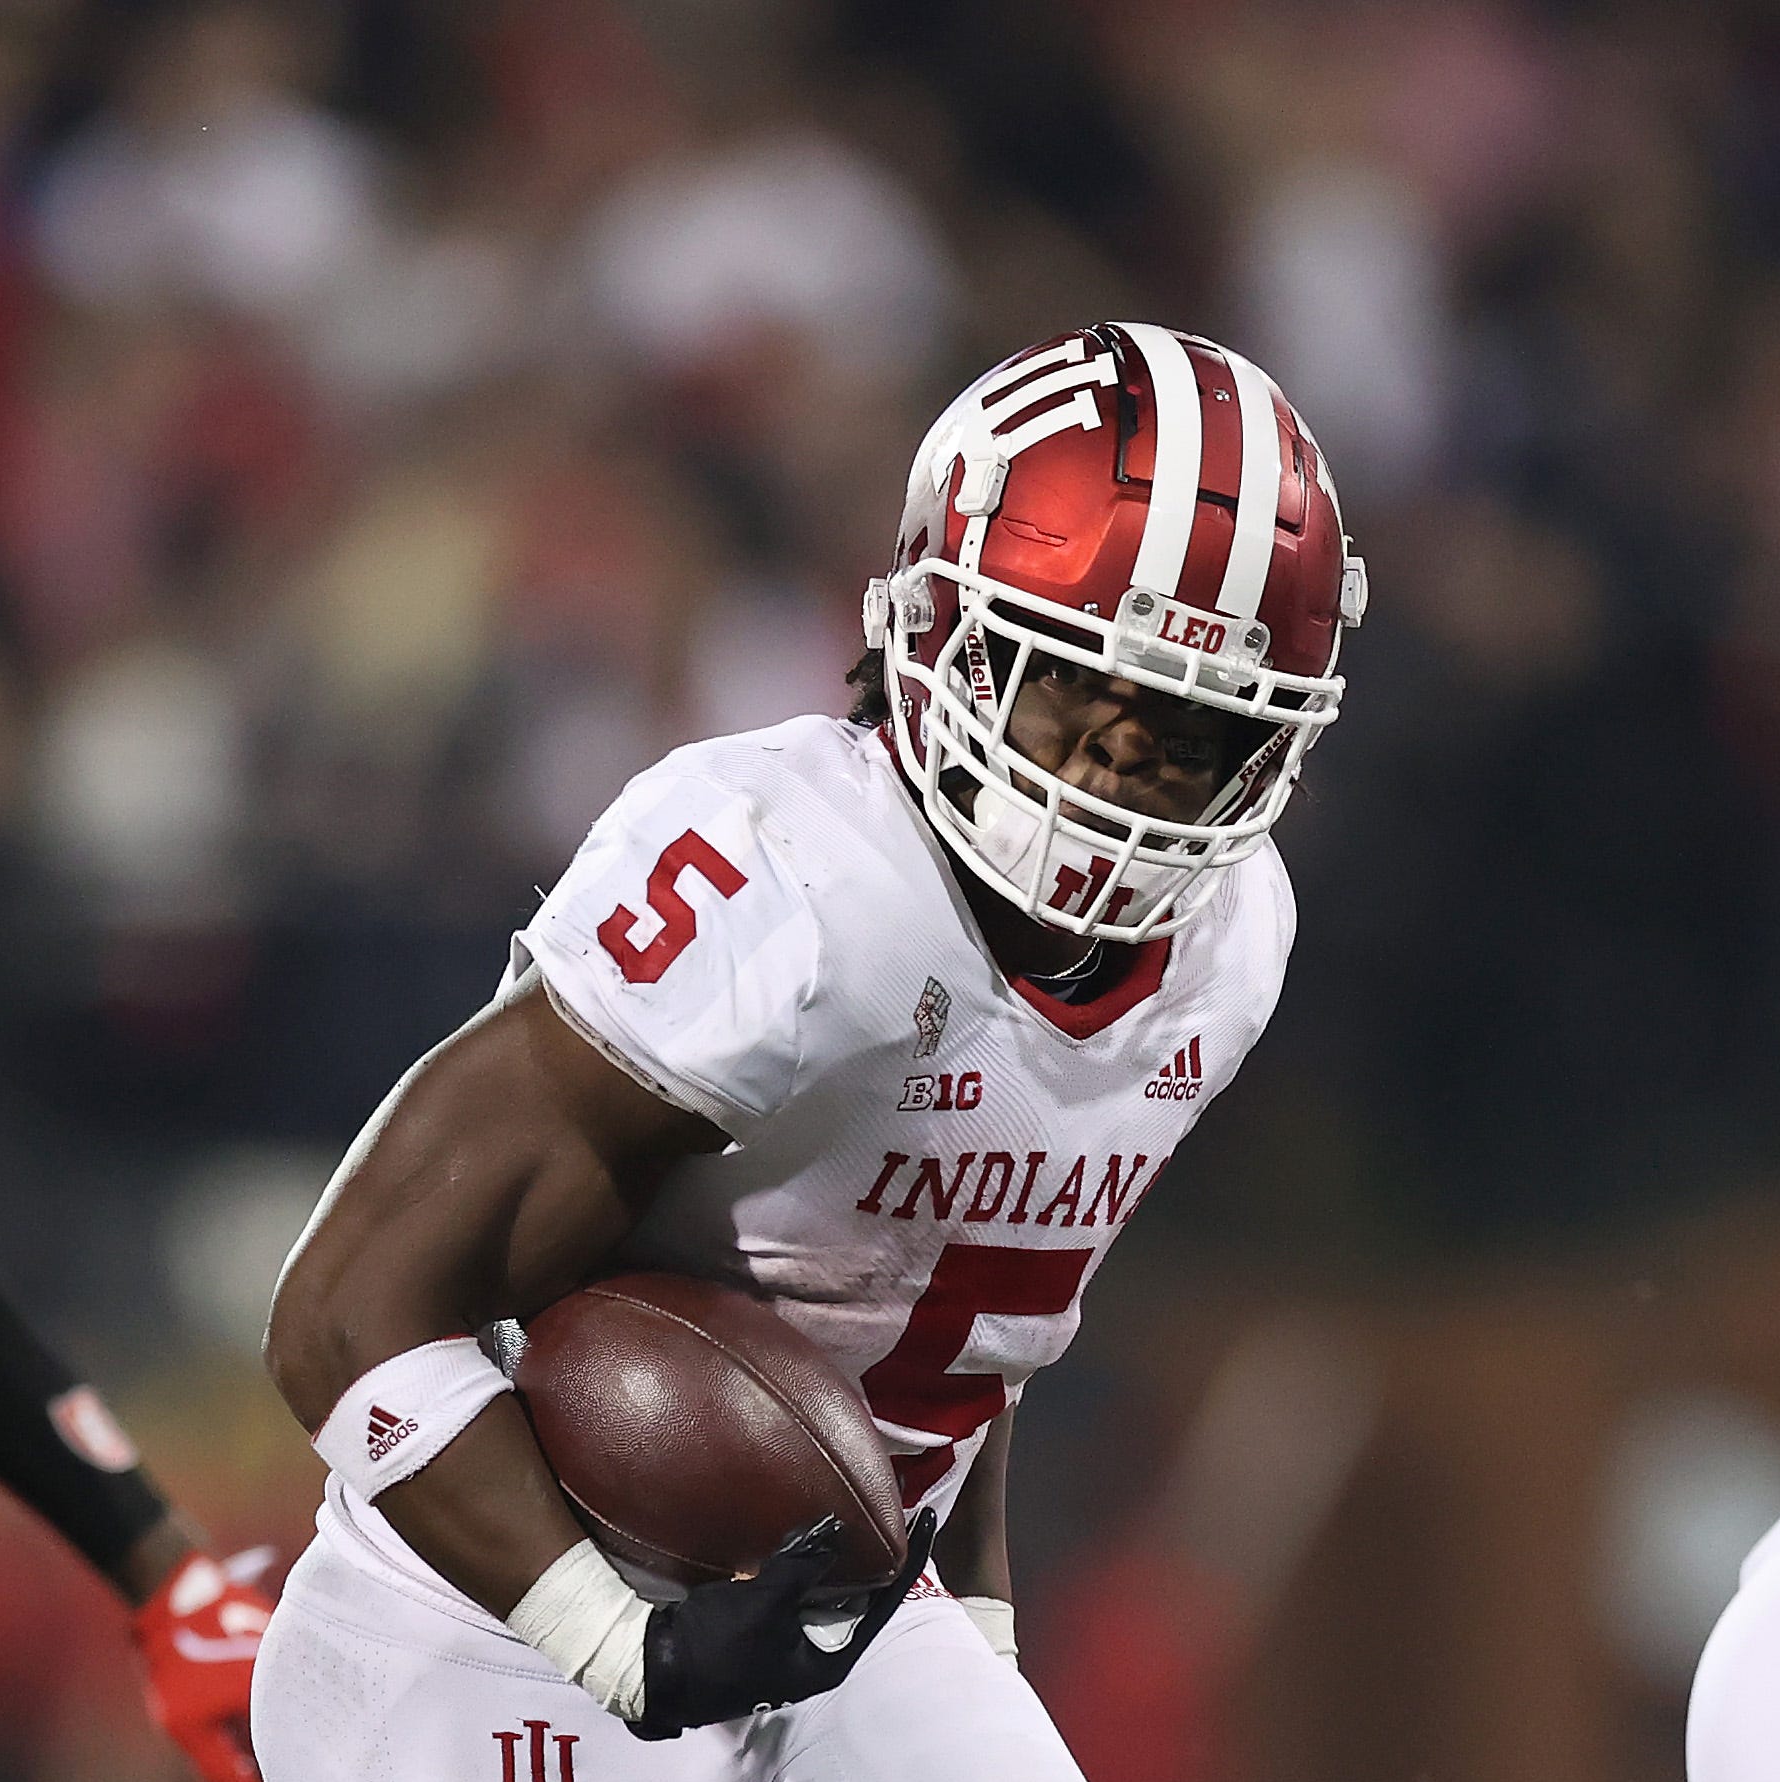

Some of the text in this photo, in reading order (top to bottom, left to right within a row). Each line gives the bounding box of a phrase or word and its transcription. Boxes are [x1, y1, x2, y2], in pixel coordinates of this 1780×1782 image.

[1157, 609, 1226, 654] LEO
[596, 827, 749, 984] 5
[860, 1242, 1096, 1510] 5
[368, 1416, 420, 1463] adidas
